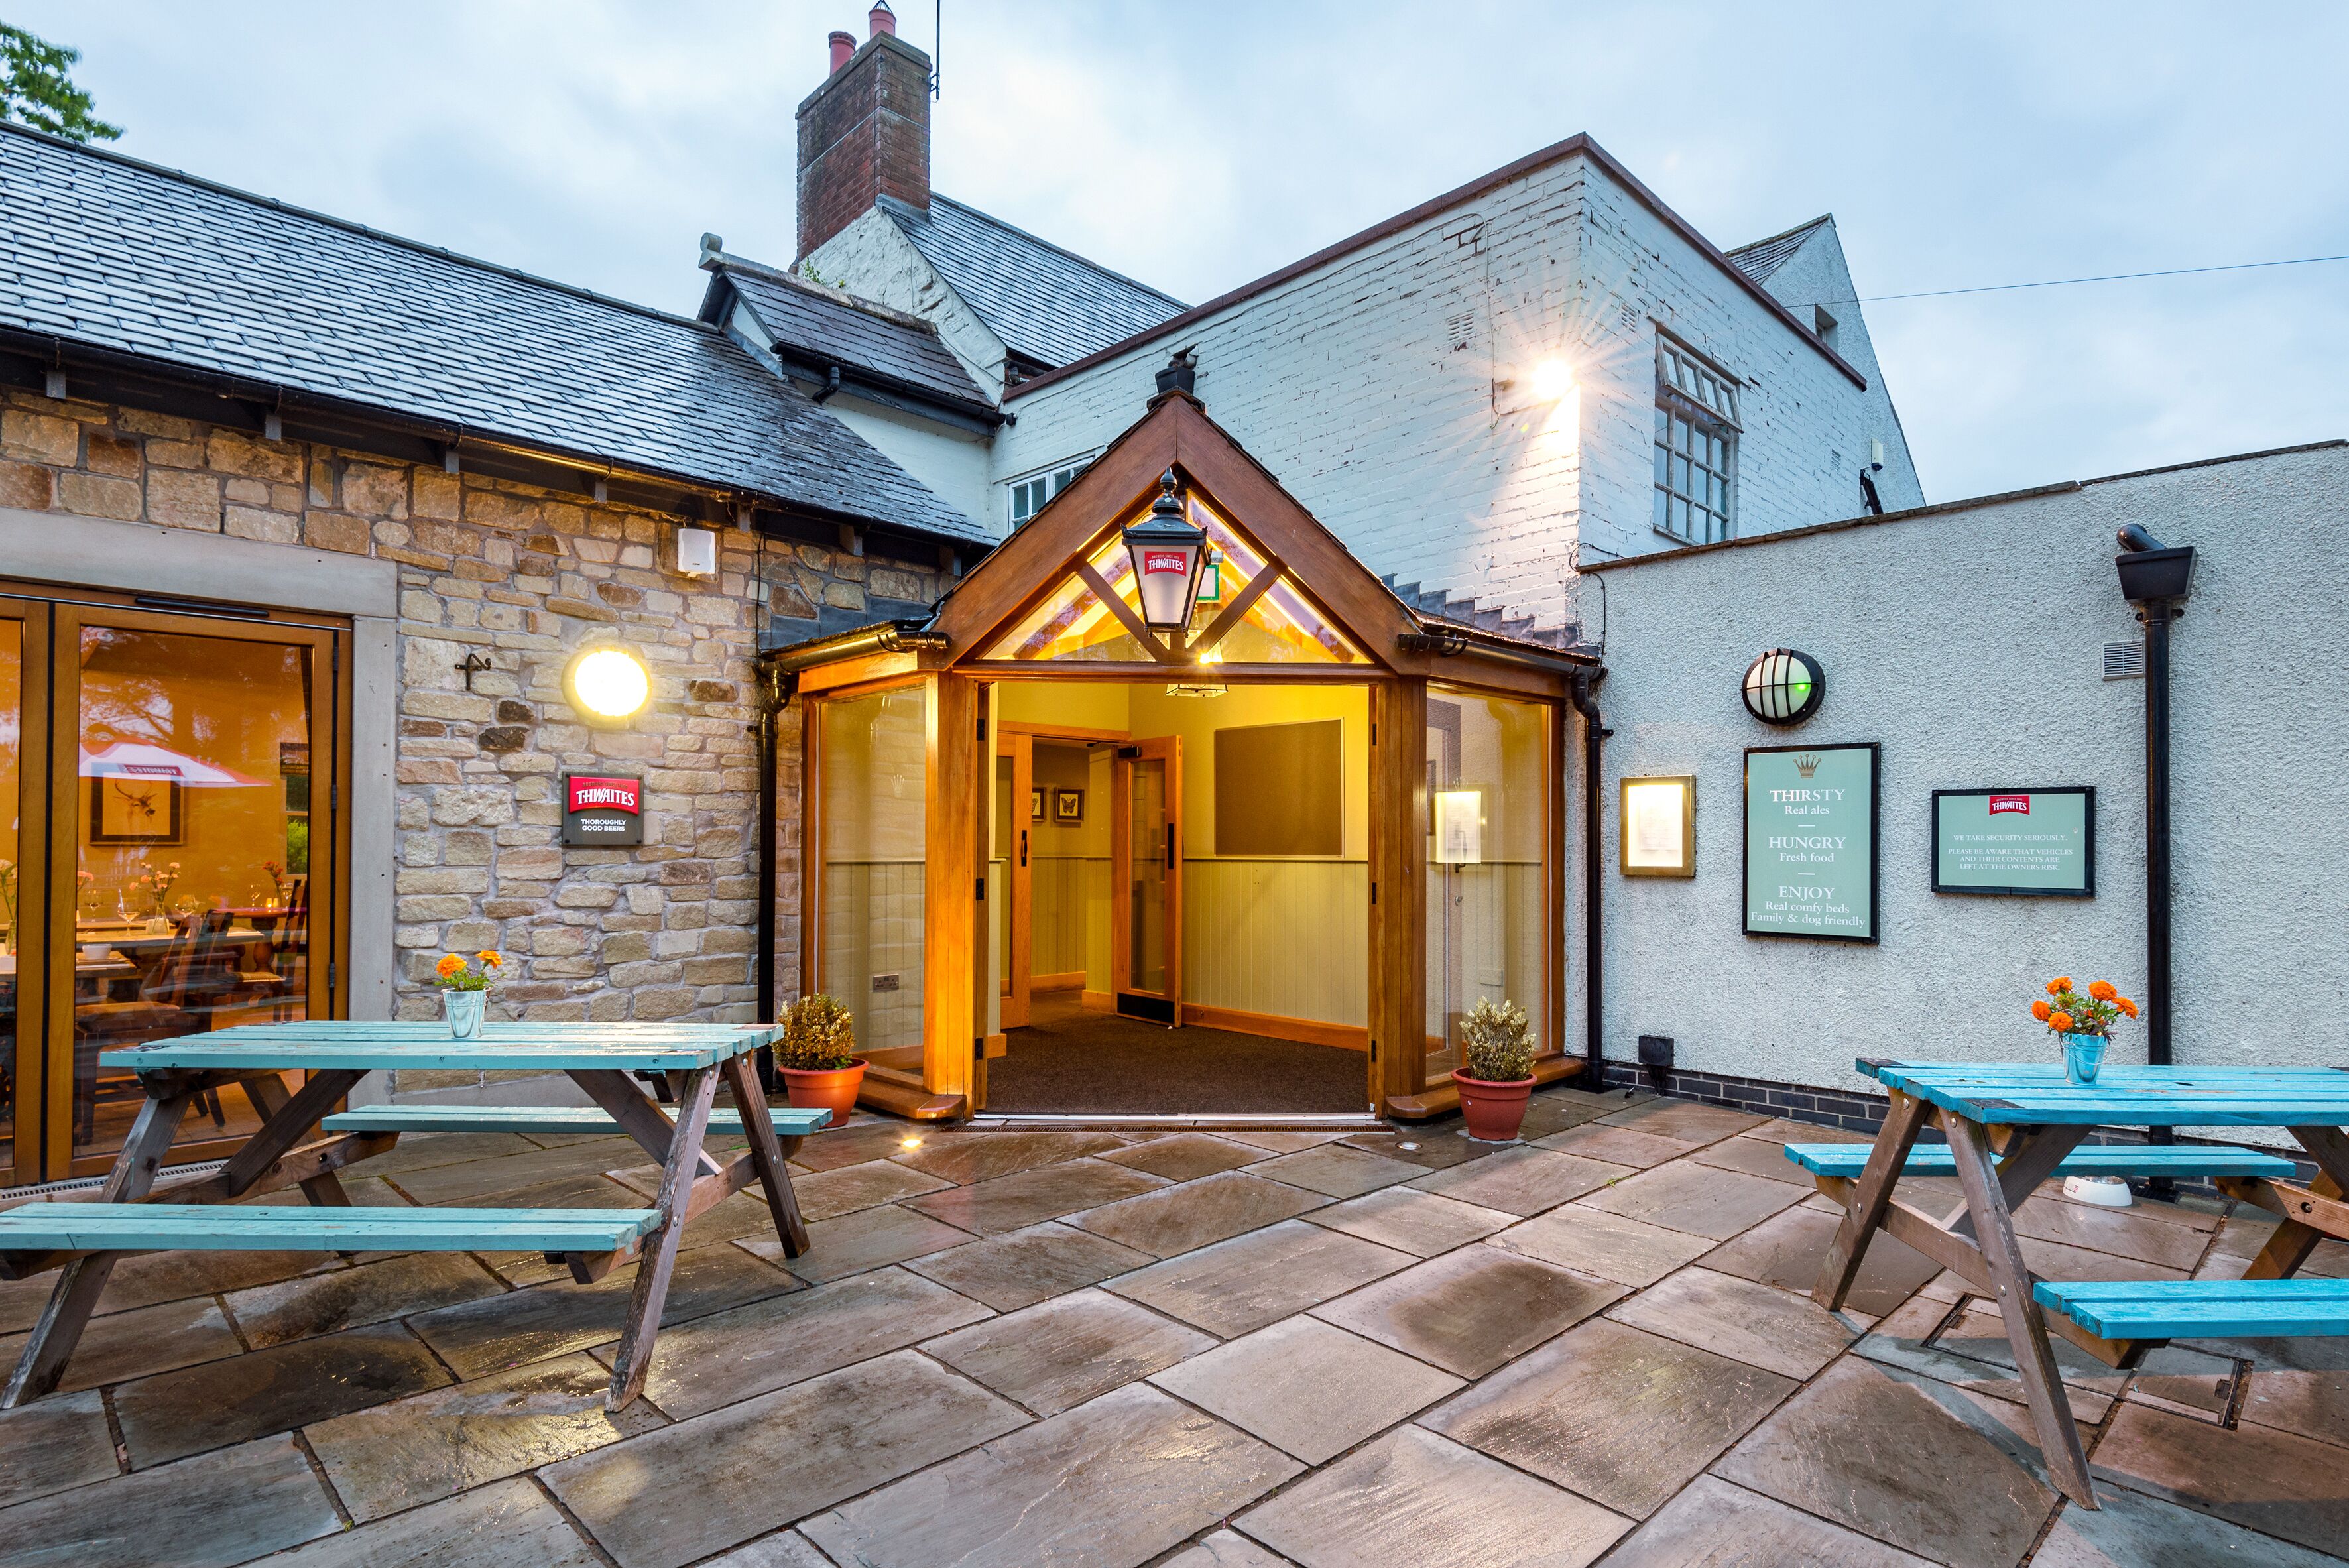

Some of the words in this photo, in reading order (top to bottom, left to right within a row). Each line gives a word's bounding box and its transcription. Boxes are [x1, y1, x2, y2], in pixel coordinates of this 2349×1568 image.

[1148, 558, 1184, 572] THWAITES
[575, 788, 634, 807] THWAITES
[1769, 788, 1846, 802] THIRSTY
[1784, 805, 1807, 815] Real
[1810, 804, 1831, 814] ales
[1992, 800, 2027, 811] THWAITES
[1768, 837, 1846, 849] HUNGRY
[1779, 852, 1807, 862] Fresh
[1811, 852, 1835, 863] food
[1778, 886, 1835, 902] ENJOY
[1766, 901, 1787, 910] Real
[1791, 902, 1823, 914] comfy
[1825, 903, 1850, 914] beds
[1751, 912, 1784, 924] Family
[1787, 914, 1799, 923] &
[1801, 914, 1822, 926] dog
[1825, 915, 1866, 928] friendly
